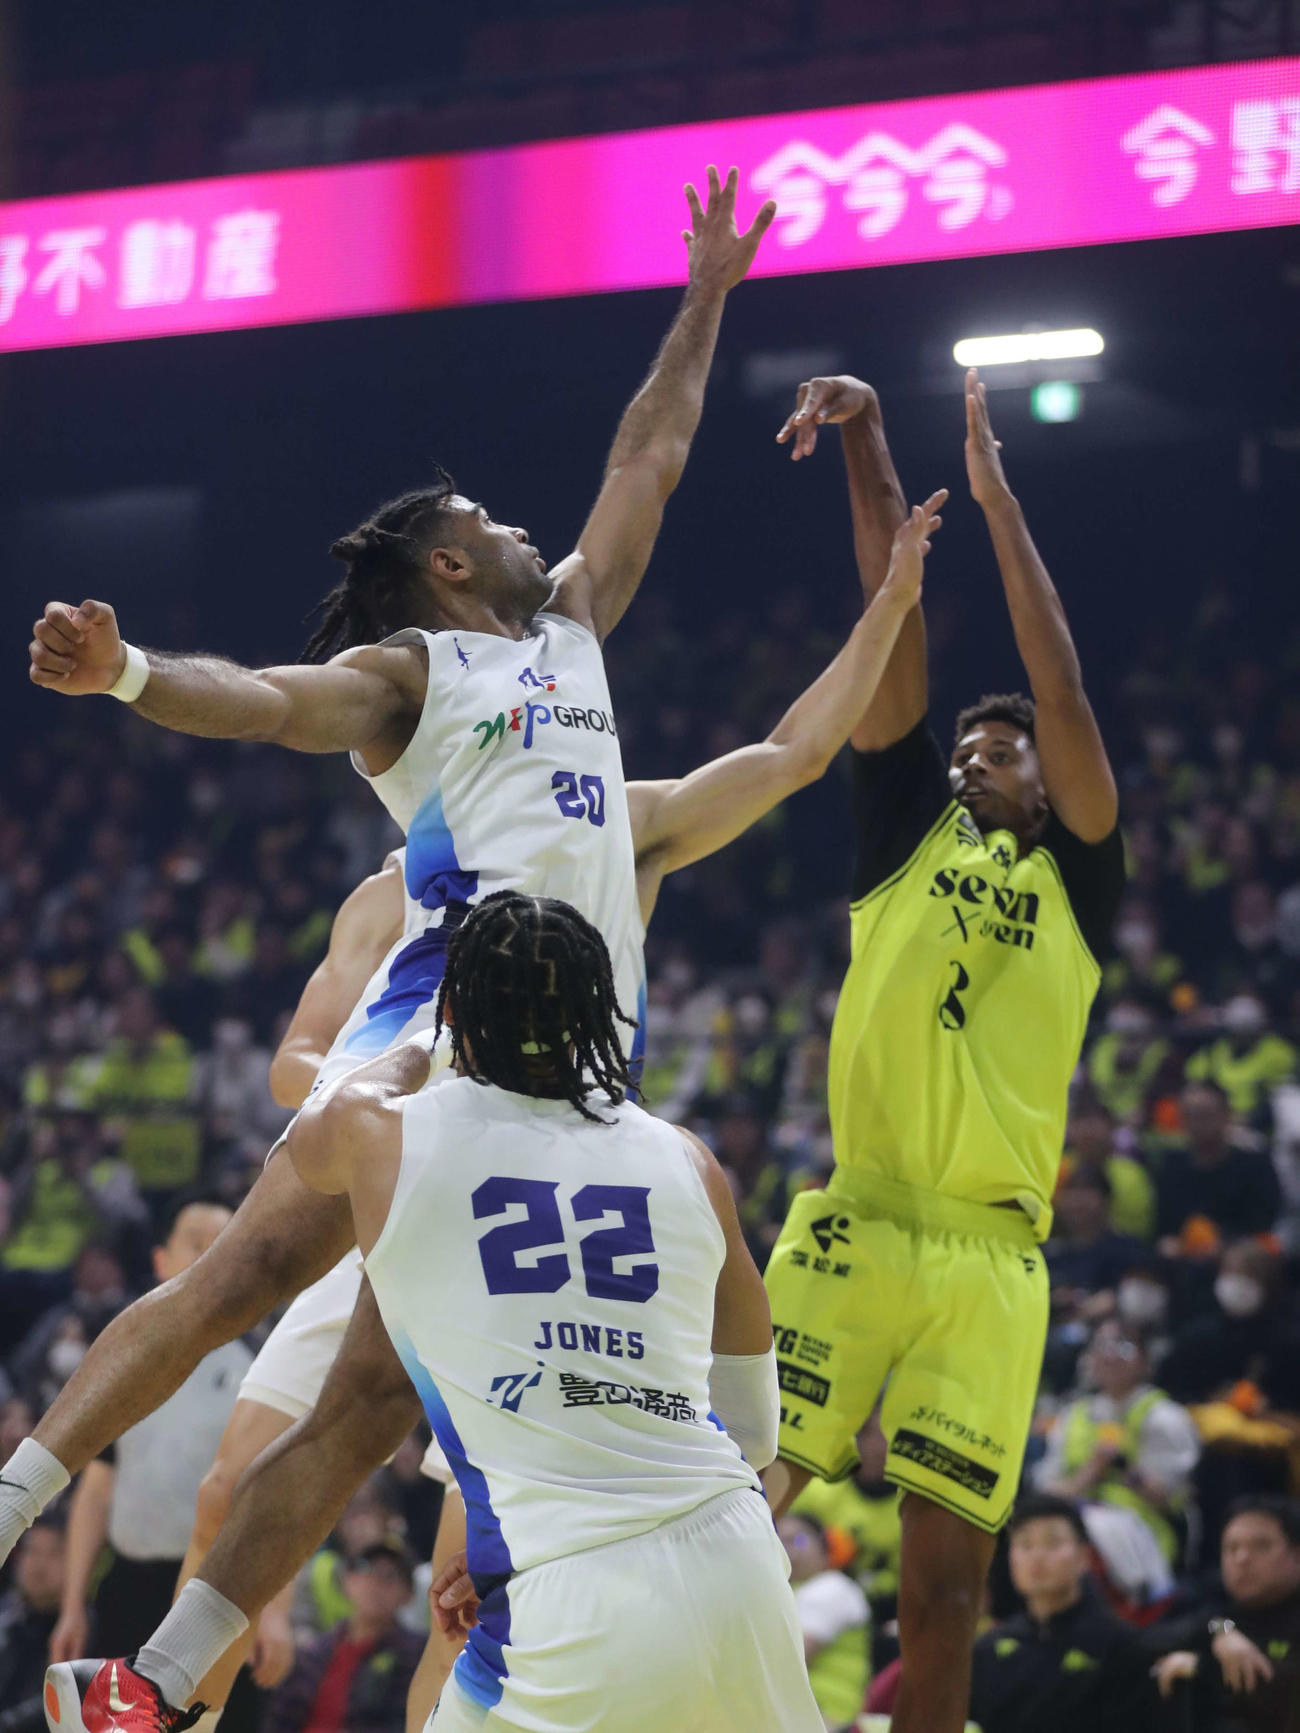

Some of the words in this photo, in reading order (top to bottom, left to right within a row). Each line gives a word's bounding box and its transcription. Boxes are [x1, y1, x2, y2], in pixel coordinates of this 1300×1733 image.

[552, 770, 605, 827] 20
[471, 1176, 659, 1303] 22
[534, 1321, 645, 1360] JONES
